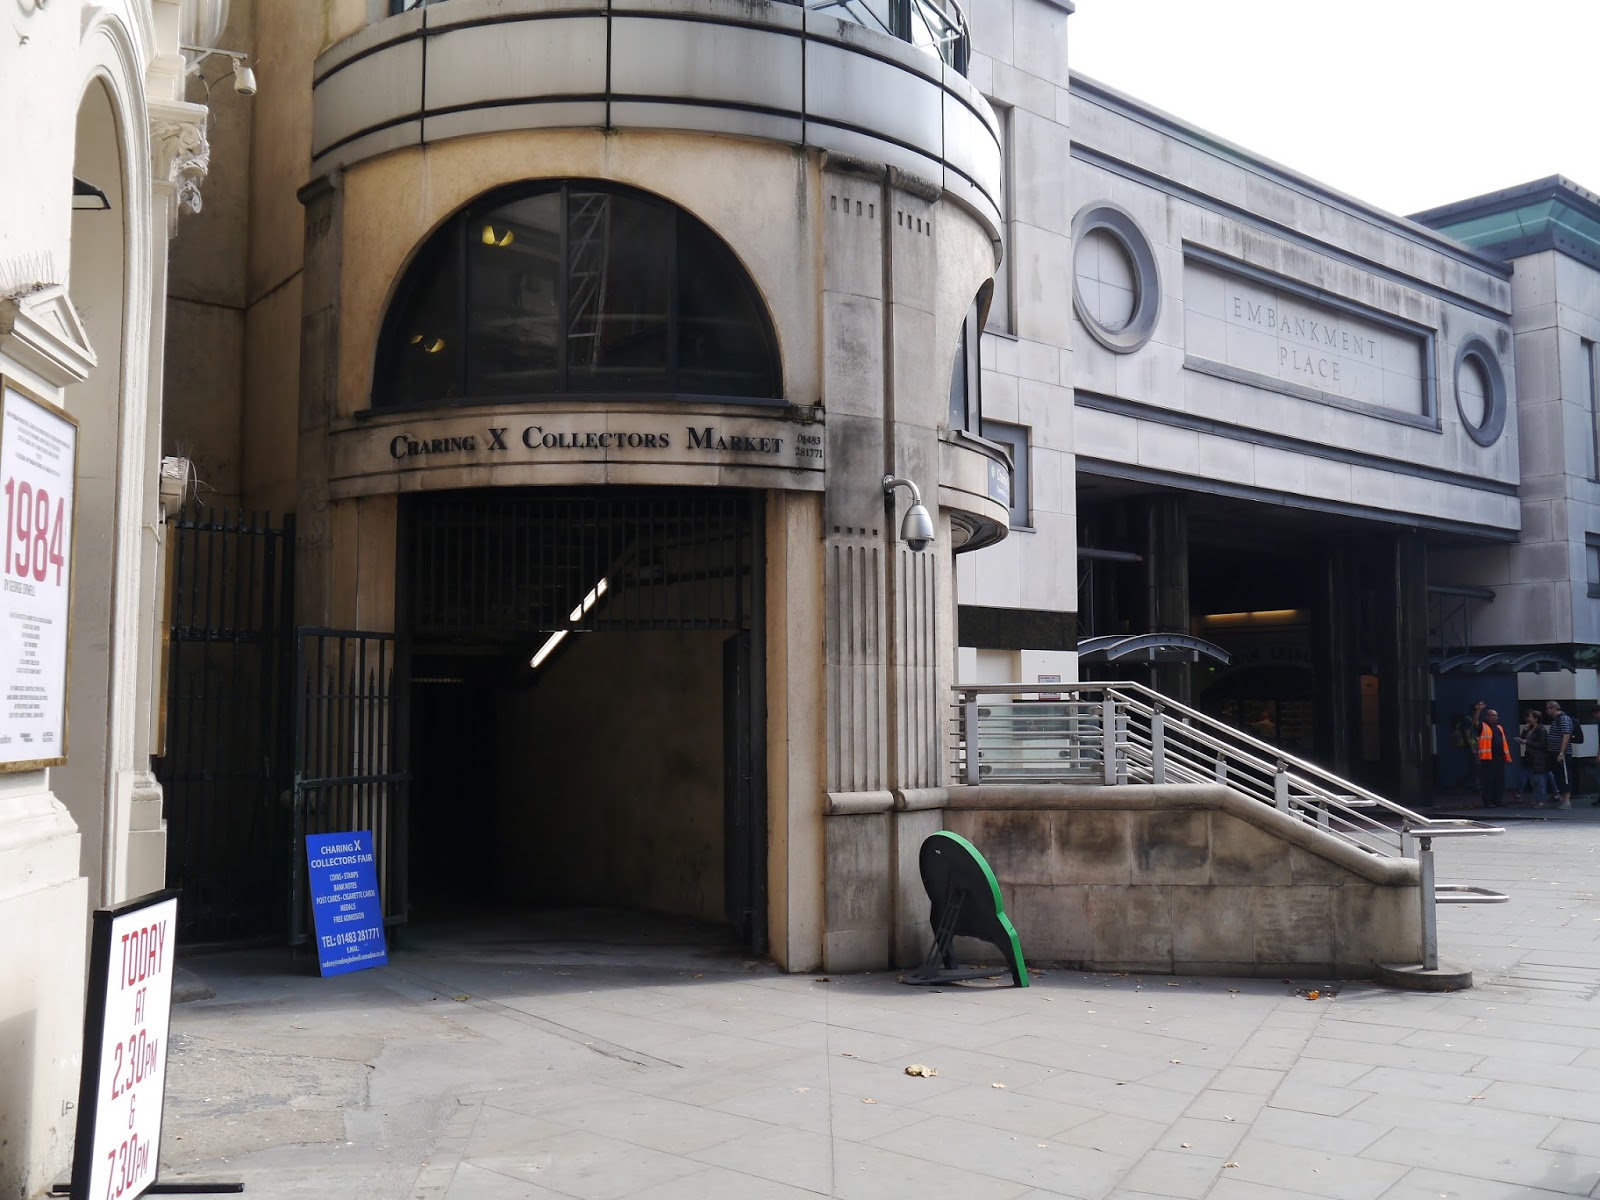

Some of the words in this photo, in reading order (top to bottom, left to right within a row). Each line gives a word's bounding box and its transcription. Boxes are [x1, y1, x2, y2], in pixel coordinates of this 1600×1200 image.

[1233, 297, 1375, 359] EMBANKMENT
[1280, 346, 1340, 381] PLACE
[390, 434, 476, 459] CHARING
[487, 427, 508, 450] X
[522, 425, 670, 449] COLLECTORS
[686, 426, 784, 454] MARKET
[797, 434, 821, 445] 01483
[795, 447, 823, 458] 281771
[4, 476, 64, 587] 1984
[320, 843, 354, 855] CHARING
[354, 840, 361, 851] X
[311, 855, 357, 868] COLLECTORS
[357, 854, 373, 863] FAIR
[329, 873, 342, 881] COINS
[344, 871, 359, 880] STAMPS
[316, 896, 327, 904] POST
[327, 894, 341, 903] CARDS
[342, 891, 363, 900] CIGARETTE
[363, 890, 375, 898] CARDS
[340, 903, 356, 911] MEDALS
[333, 915, 343, 923] FREE
[343, 912, 365, 921] ADMISSION
[321, 935, 337, 948] TEL:
[337, 931, 357, 946] 01483
[357, 927, 380, 941] 281771
[121, 920, 167, 990] TODAY
[134, 986, 147, 1026] AT
[128, 1093, 136, 1130] &
